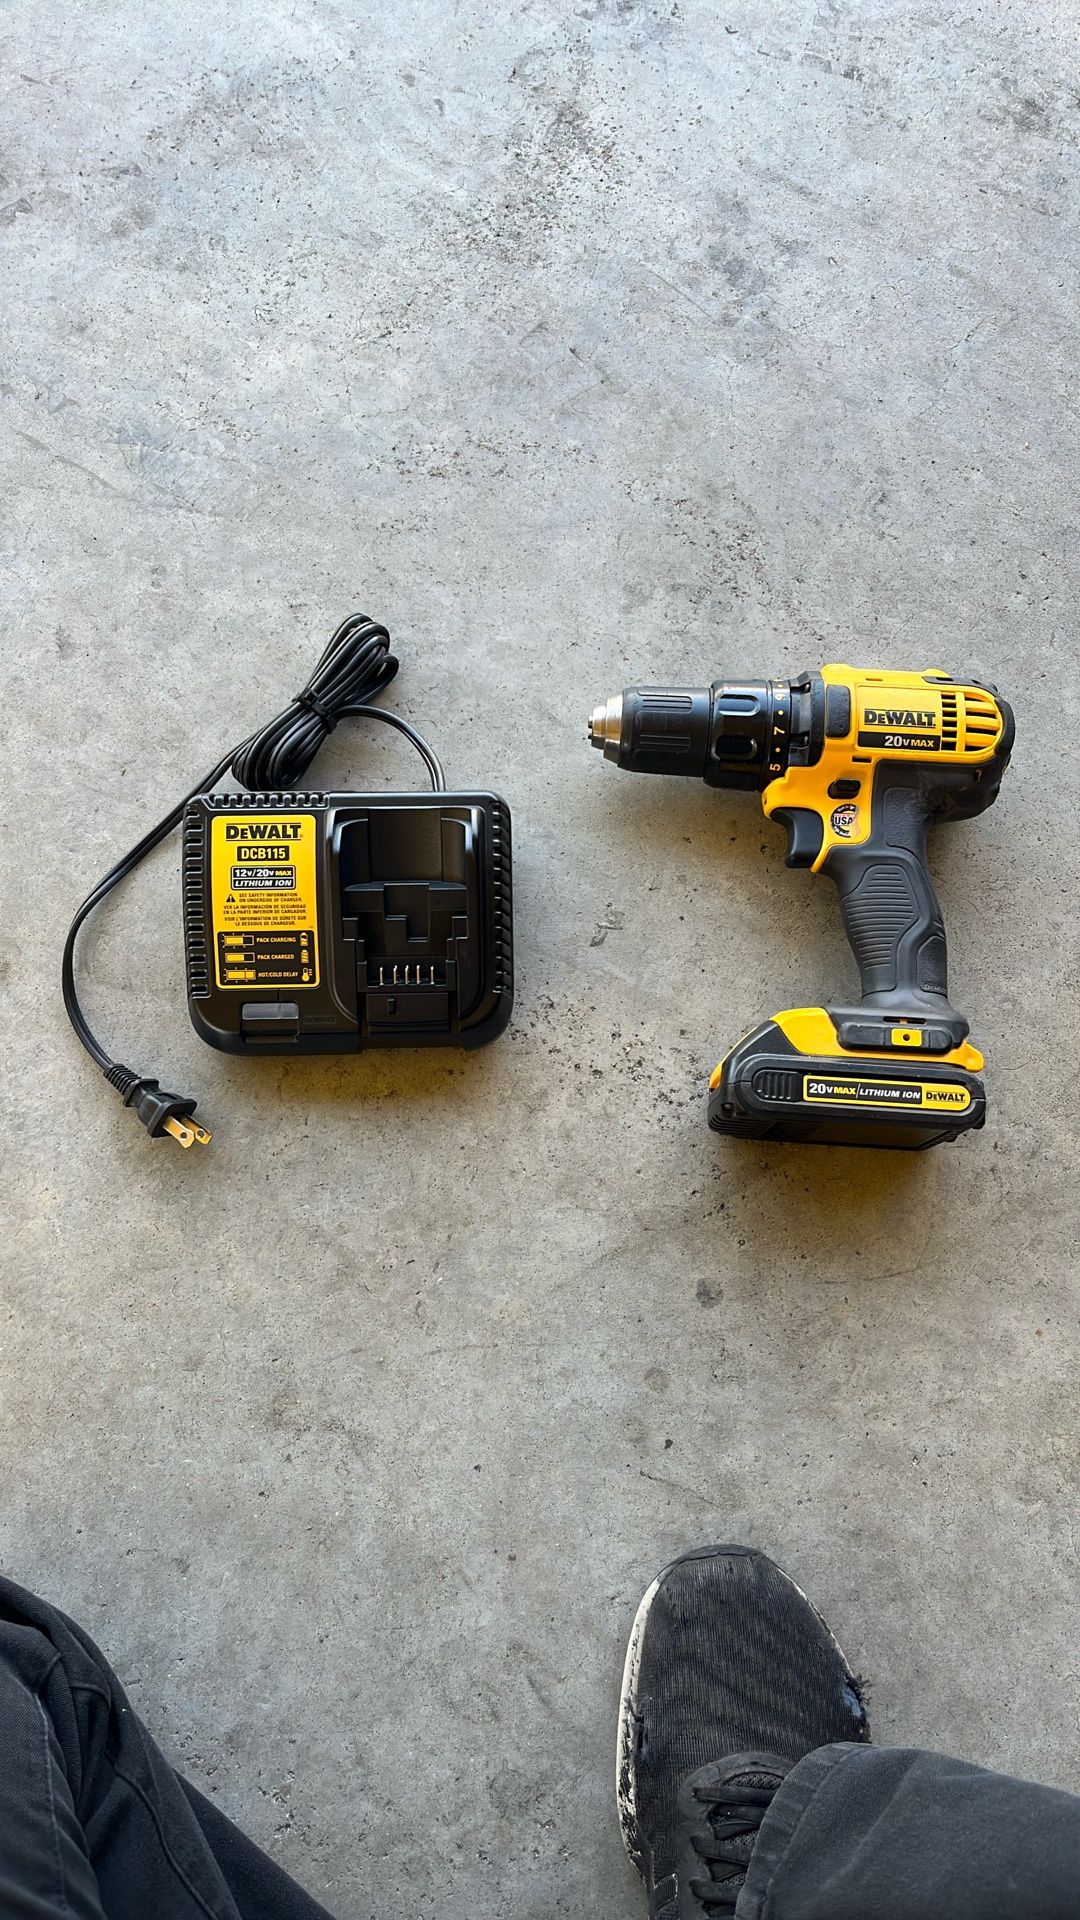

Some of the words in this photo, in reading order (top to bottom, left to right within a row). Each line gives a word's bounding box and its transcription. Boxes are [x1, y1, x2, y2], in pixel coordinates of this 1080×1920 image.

[865, 711, 935, 726] DEWALT
[774, 727, 785, 735] 7
[226, 825, 301, 839] DEWALT
[241, 848, 285, 859] DCB115
[860, 1089, 900, 1098] LITHIUM
[902, 1091, 920, 1099] ION
[926, 1092, 965, 1101] DEWALT
